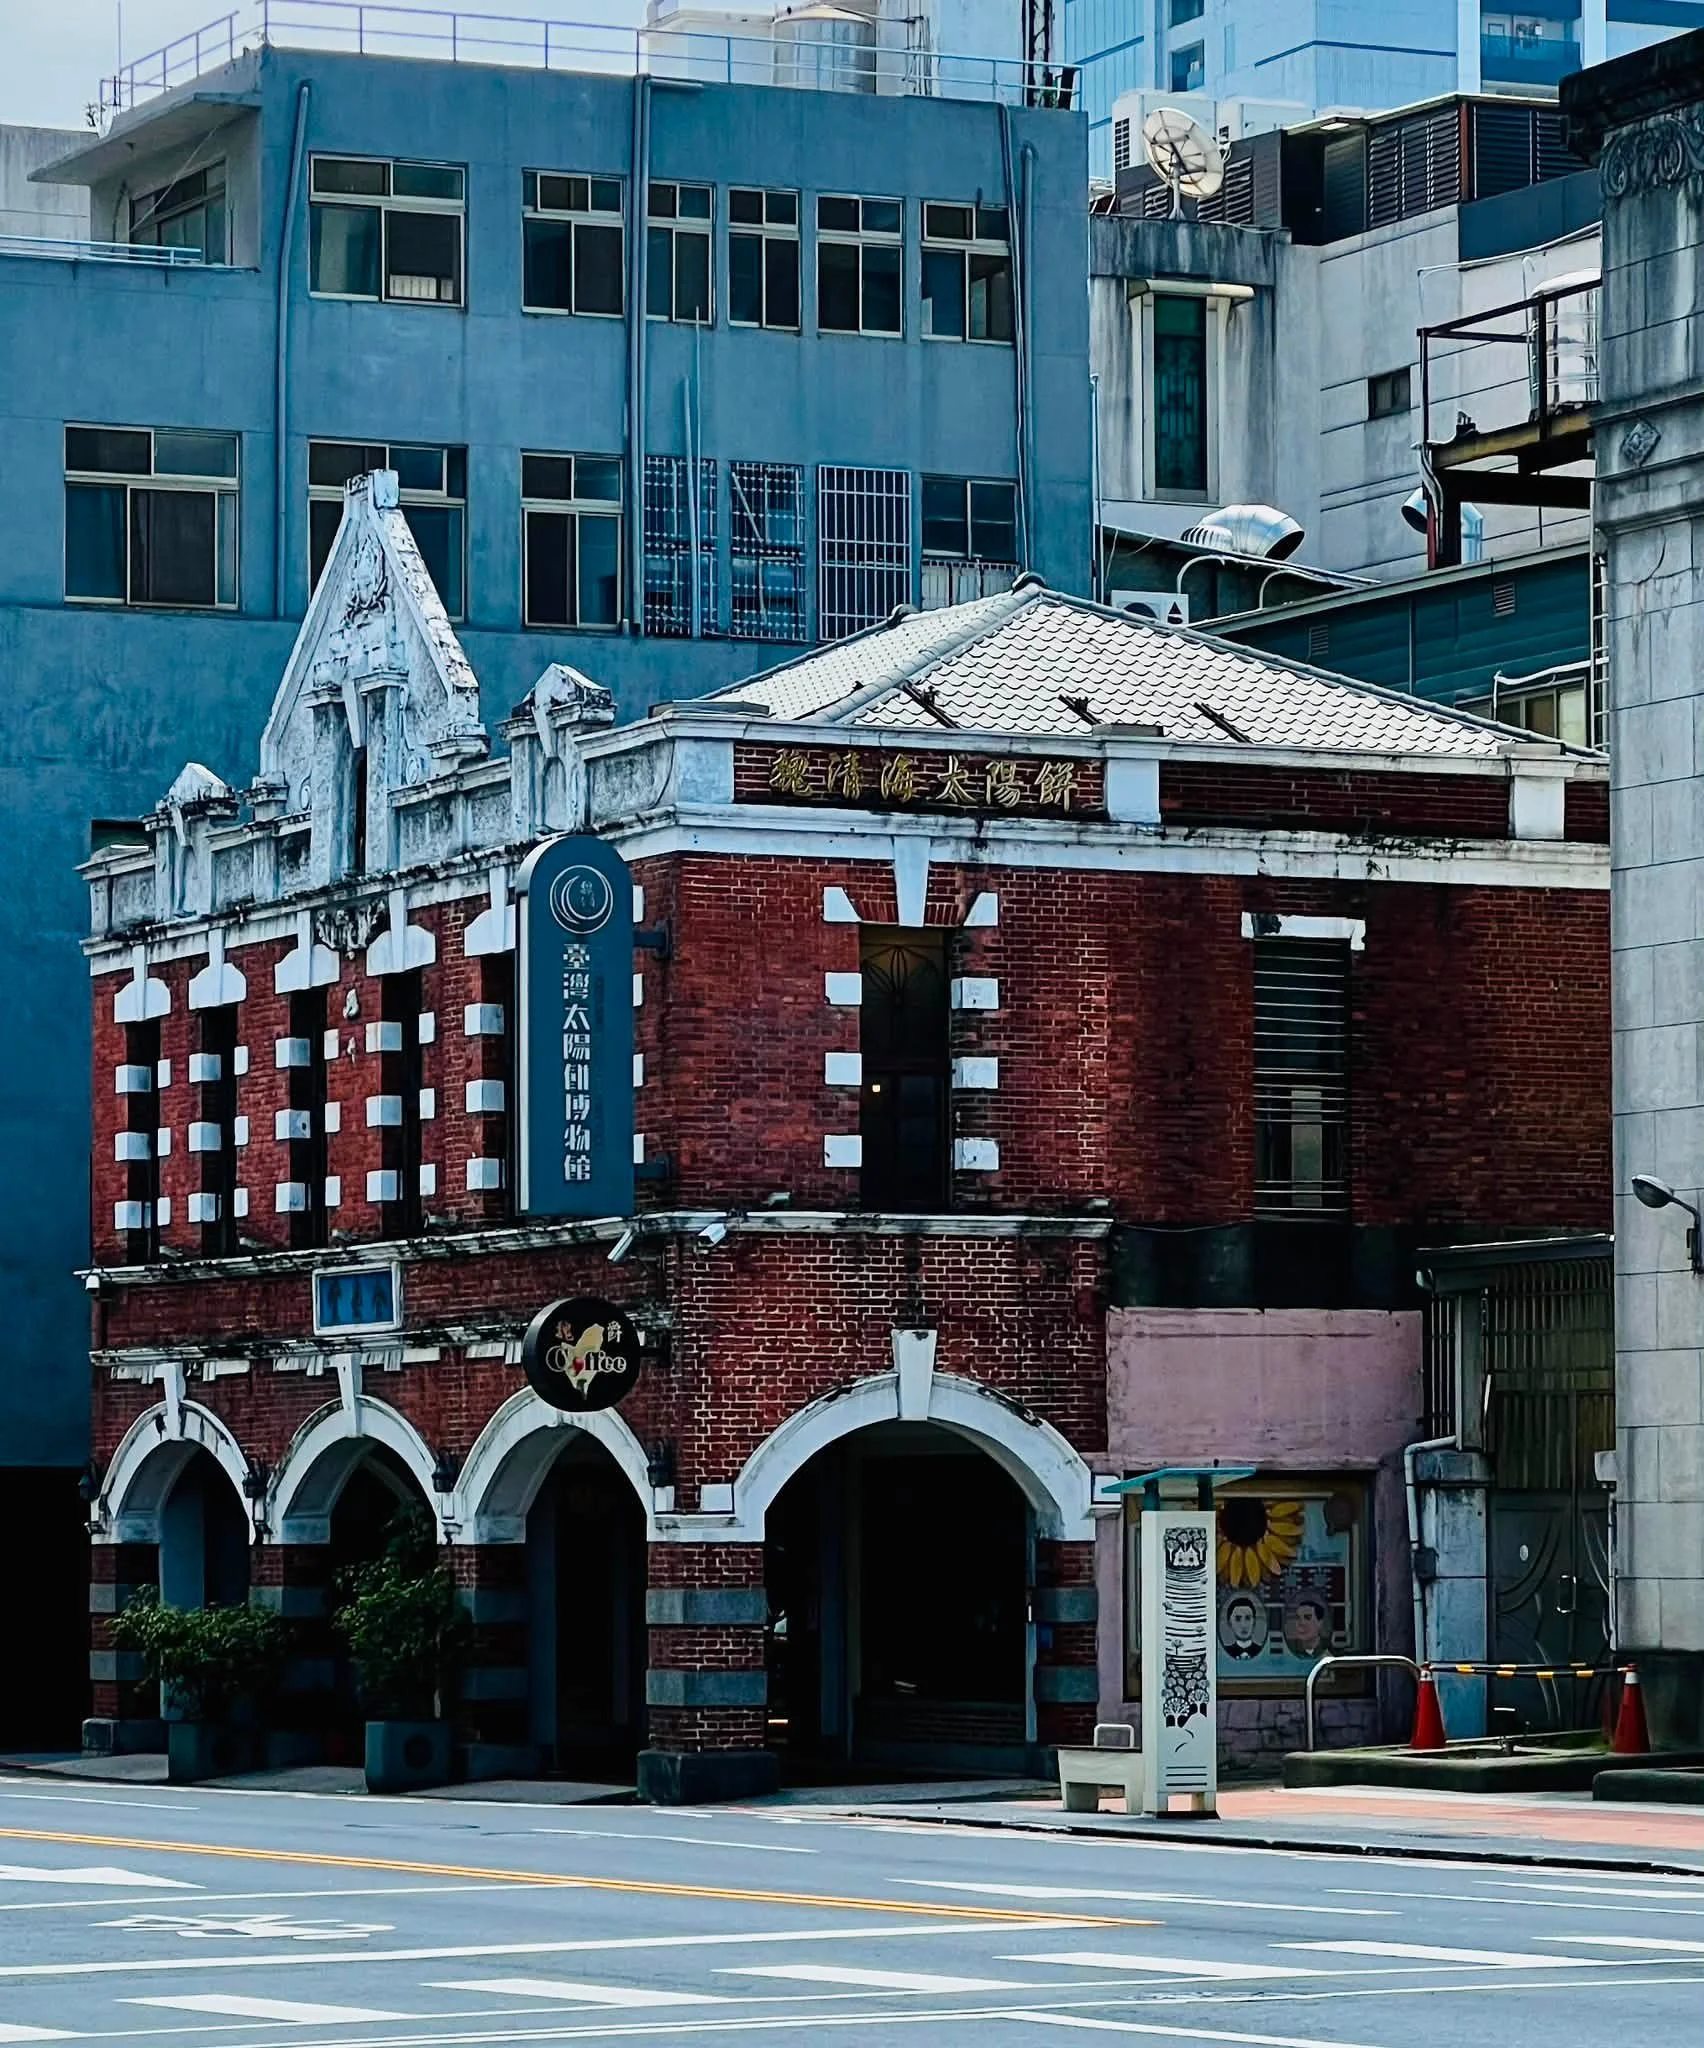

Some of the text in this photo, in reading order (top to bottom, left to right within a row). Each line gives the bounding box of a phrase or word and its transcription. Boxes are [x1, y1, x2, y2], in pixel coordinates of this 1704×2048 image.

[769, 747, 1077, 813] 魏清海太陽餅
[562, 943, 591, 1181] 臺灣太陽餅博物館
[545, 1343, 627, 1374] Cffee
